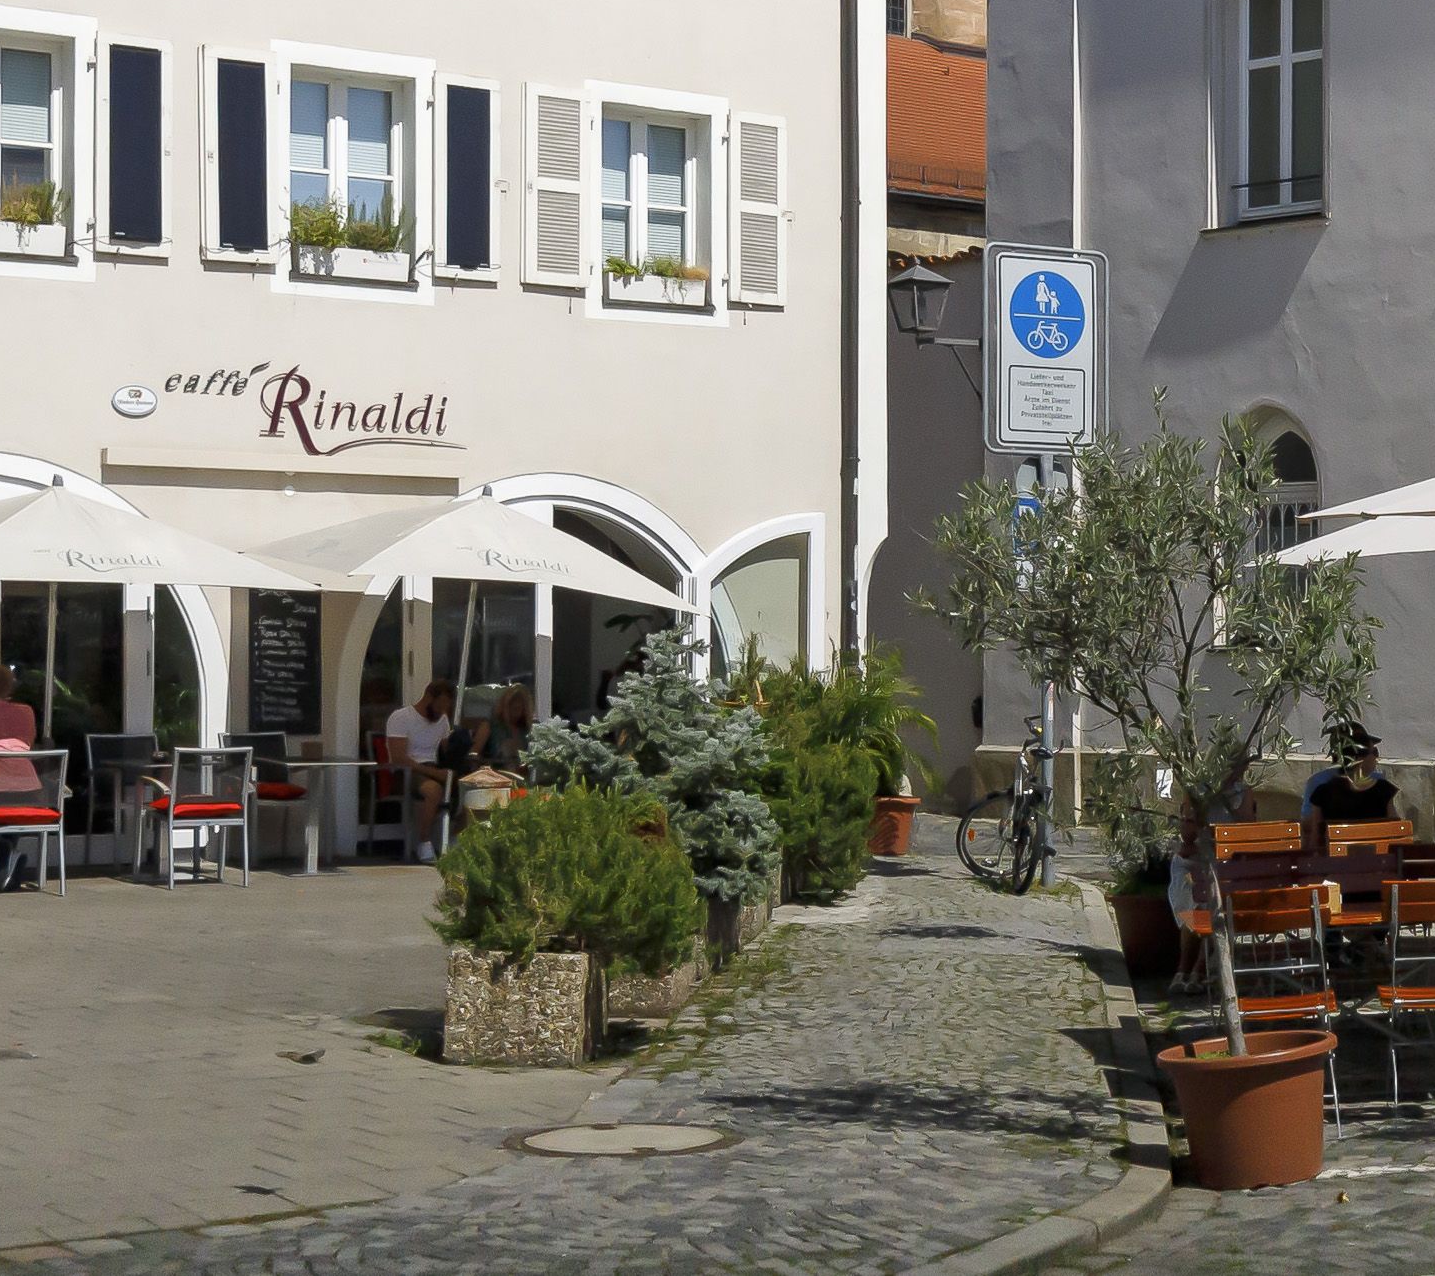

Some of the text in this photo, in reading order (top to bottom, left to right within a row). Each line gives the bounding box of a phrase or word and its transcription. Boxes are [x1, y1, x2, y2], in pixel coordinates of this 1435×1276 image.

[259, 364, 467, 456] Rinaldi
[57, 549, 164, 573] Rinaldi
[476, 549, 570, 576] Rinaldi
